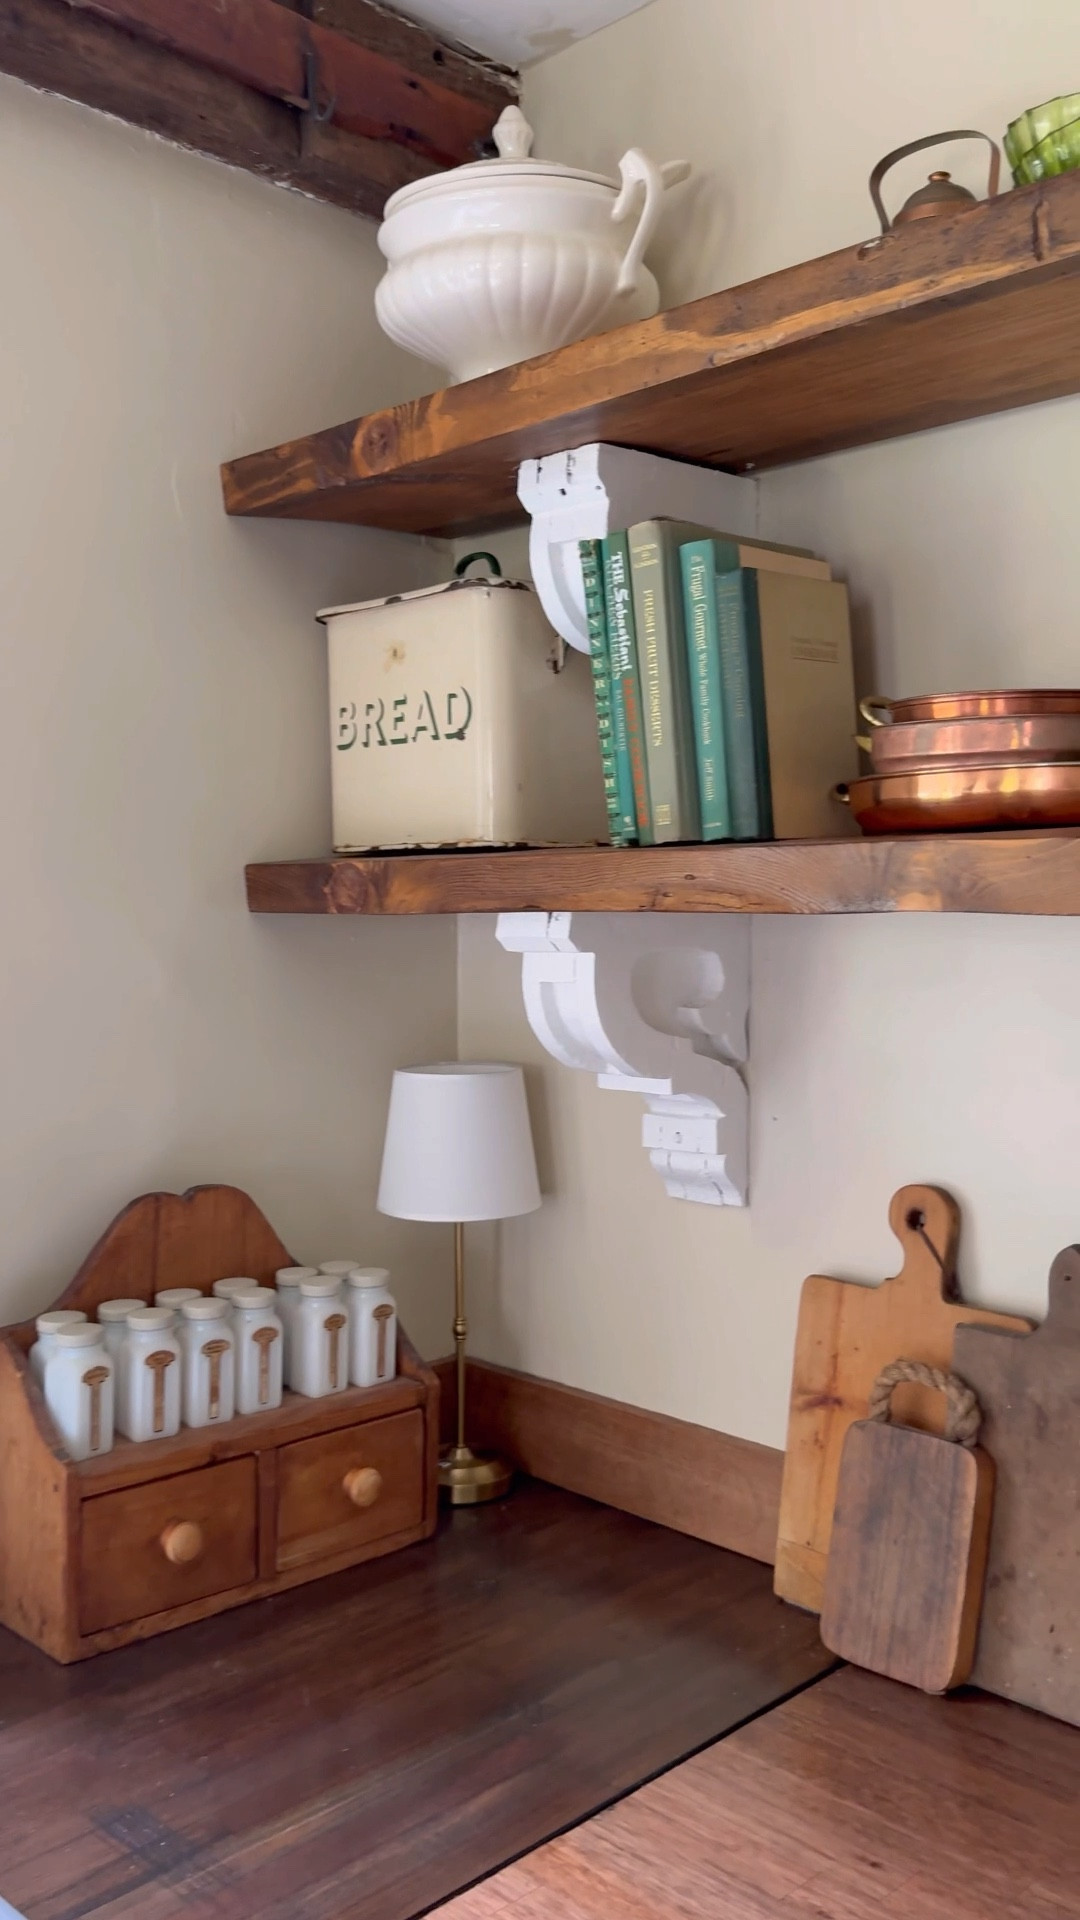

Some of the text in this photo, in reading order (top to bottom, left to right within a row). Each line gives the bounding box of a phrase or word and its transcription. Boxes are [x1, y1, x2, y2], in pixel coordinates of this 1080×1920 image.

[688, 565, 706, 600] Frugal
[611, 551, 633, 671] THE Sebastiani
[694, 603, 708, 651] Gourmet
[646, 636, 659, 677] FRUIT
[698, 652, 709, 677] Whole
[699, 679, 710, 706] Family
[336, 686, 473, 750] BREAD
[701, 708, 712, 745] Cookbook
